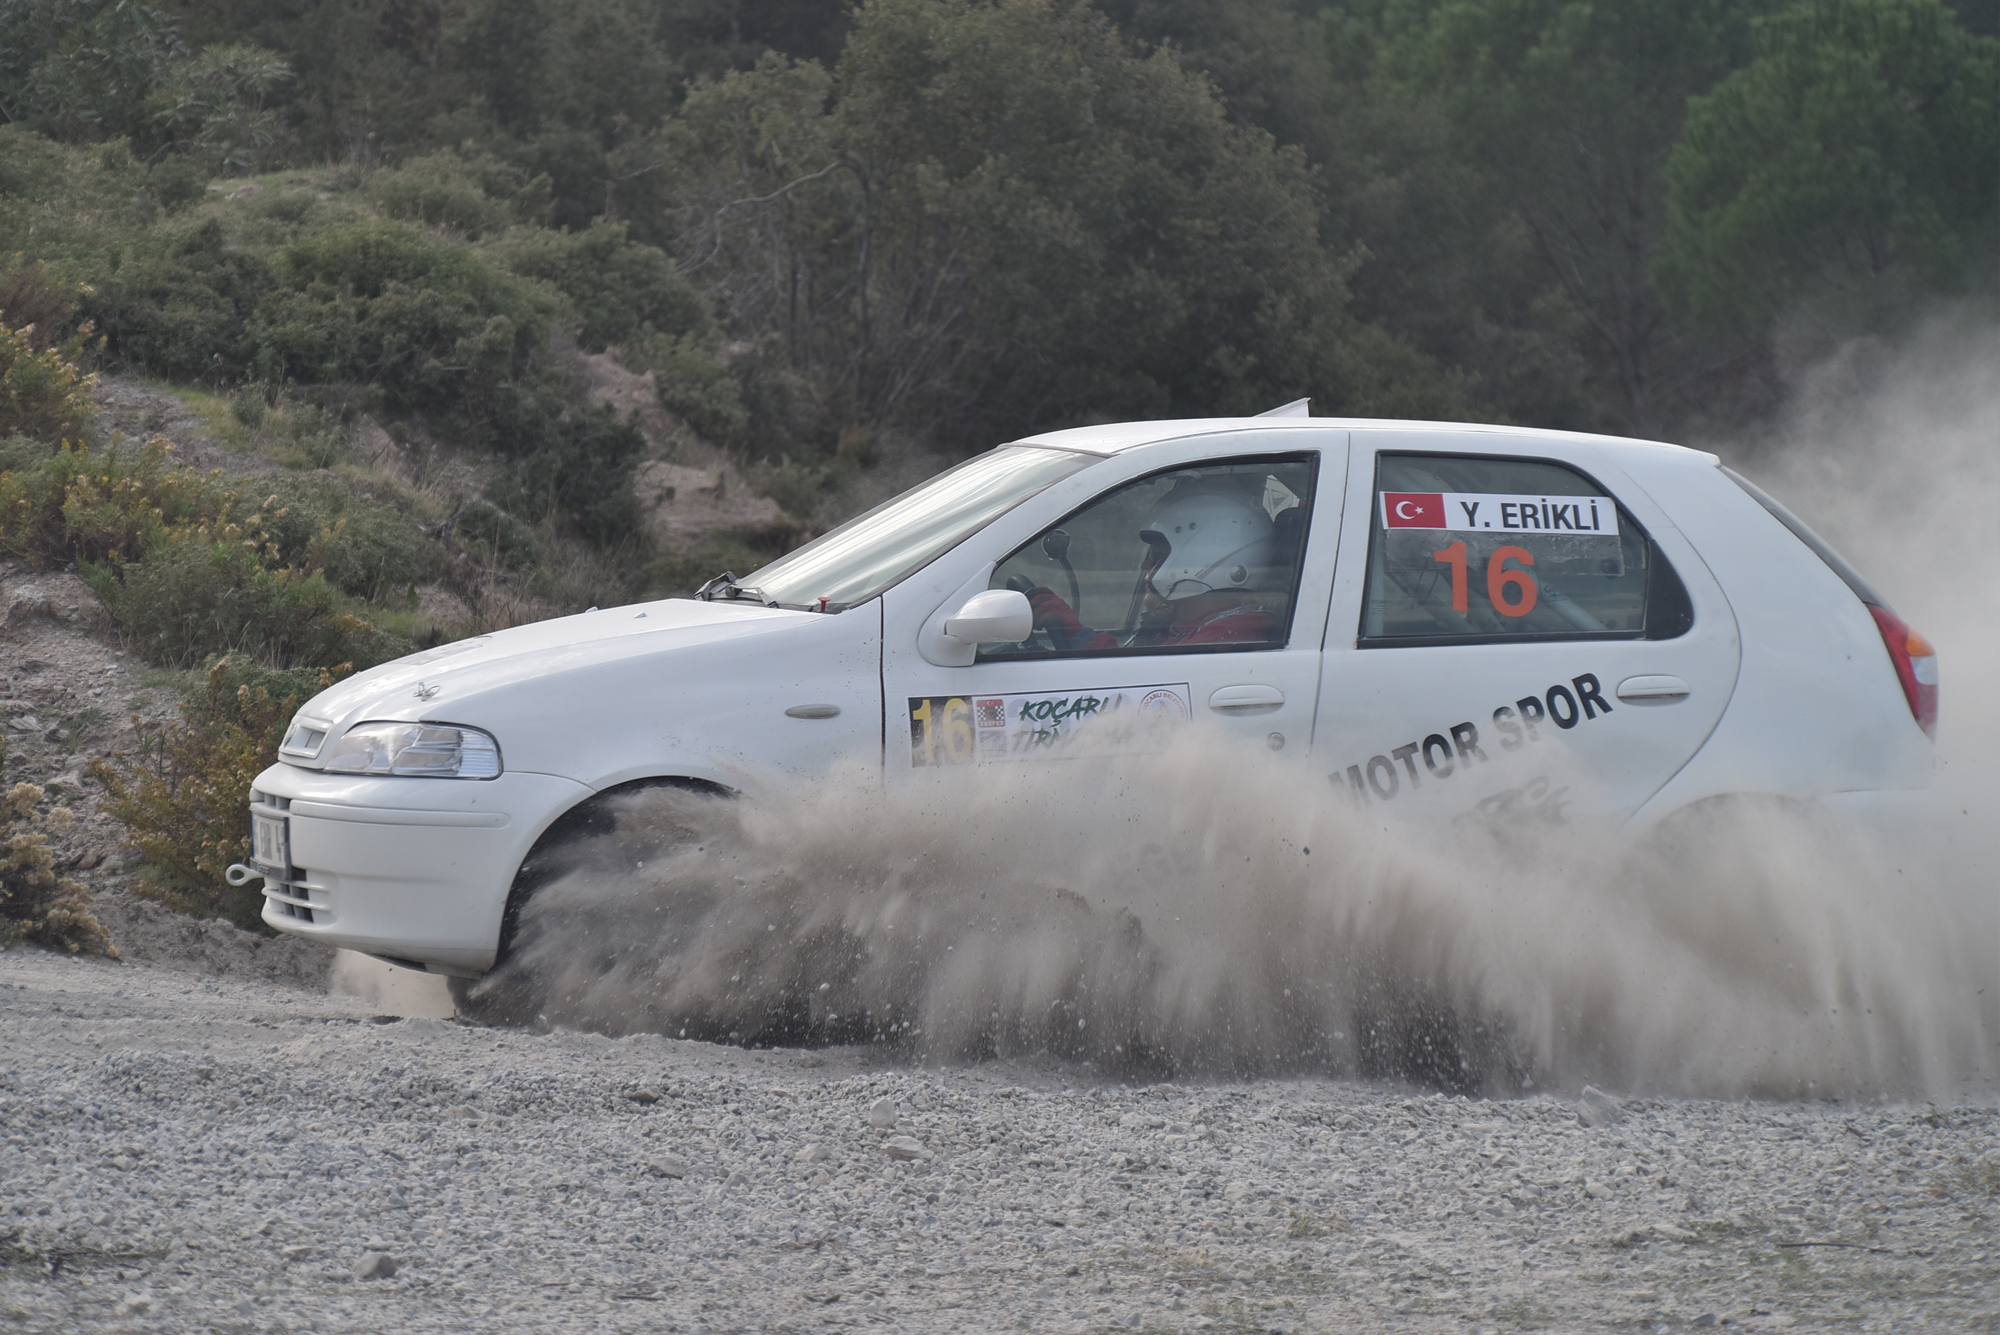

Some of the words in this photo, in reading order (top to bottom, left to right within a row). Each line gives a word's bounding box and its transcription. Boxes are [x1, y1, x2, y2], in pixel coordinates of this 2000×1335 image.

[1460, 501, 1491, 528] Y.
[1500, 498, 1601, 531] ERİKLİ
[1434, 541, 1538, 618] 16
[913, 698, 973, 764] 16
[1328, 721, 1489, 810] MOTOR
[1492, 672, 1614, 752] SPOR
